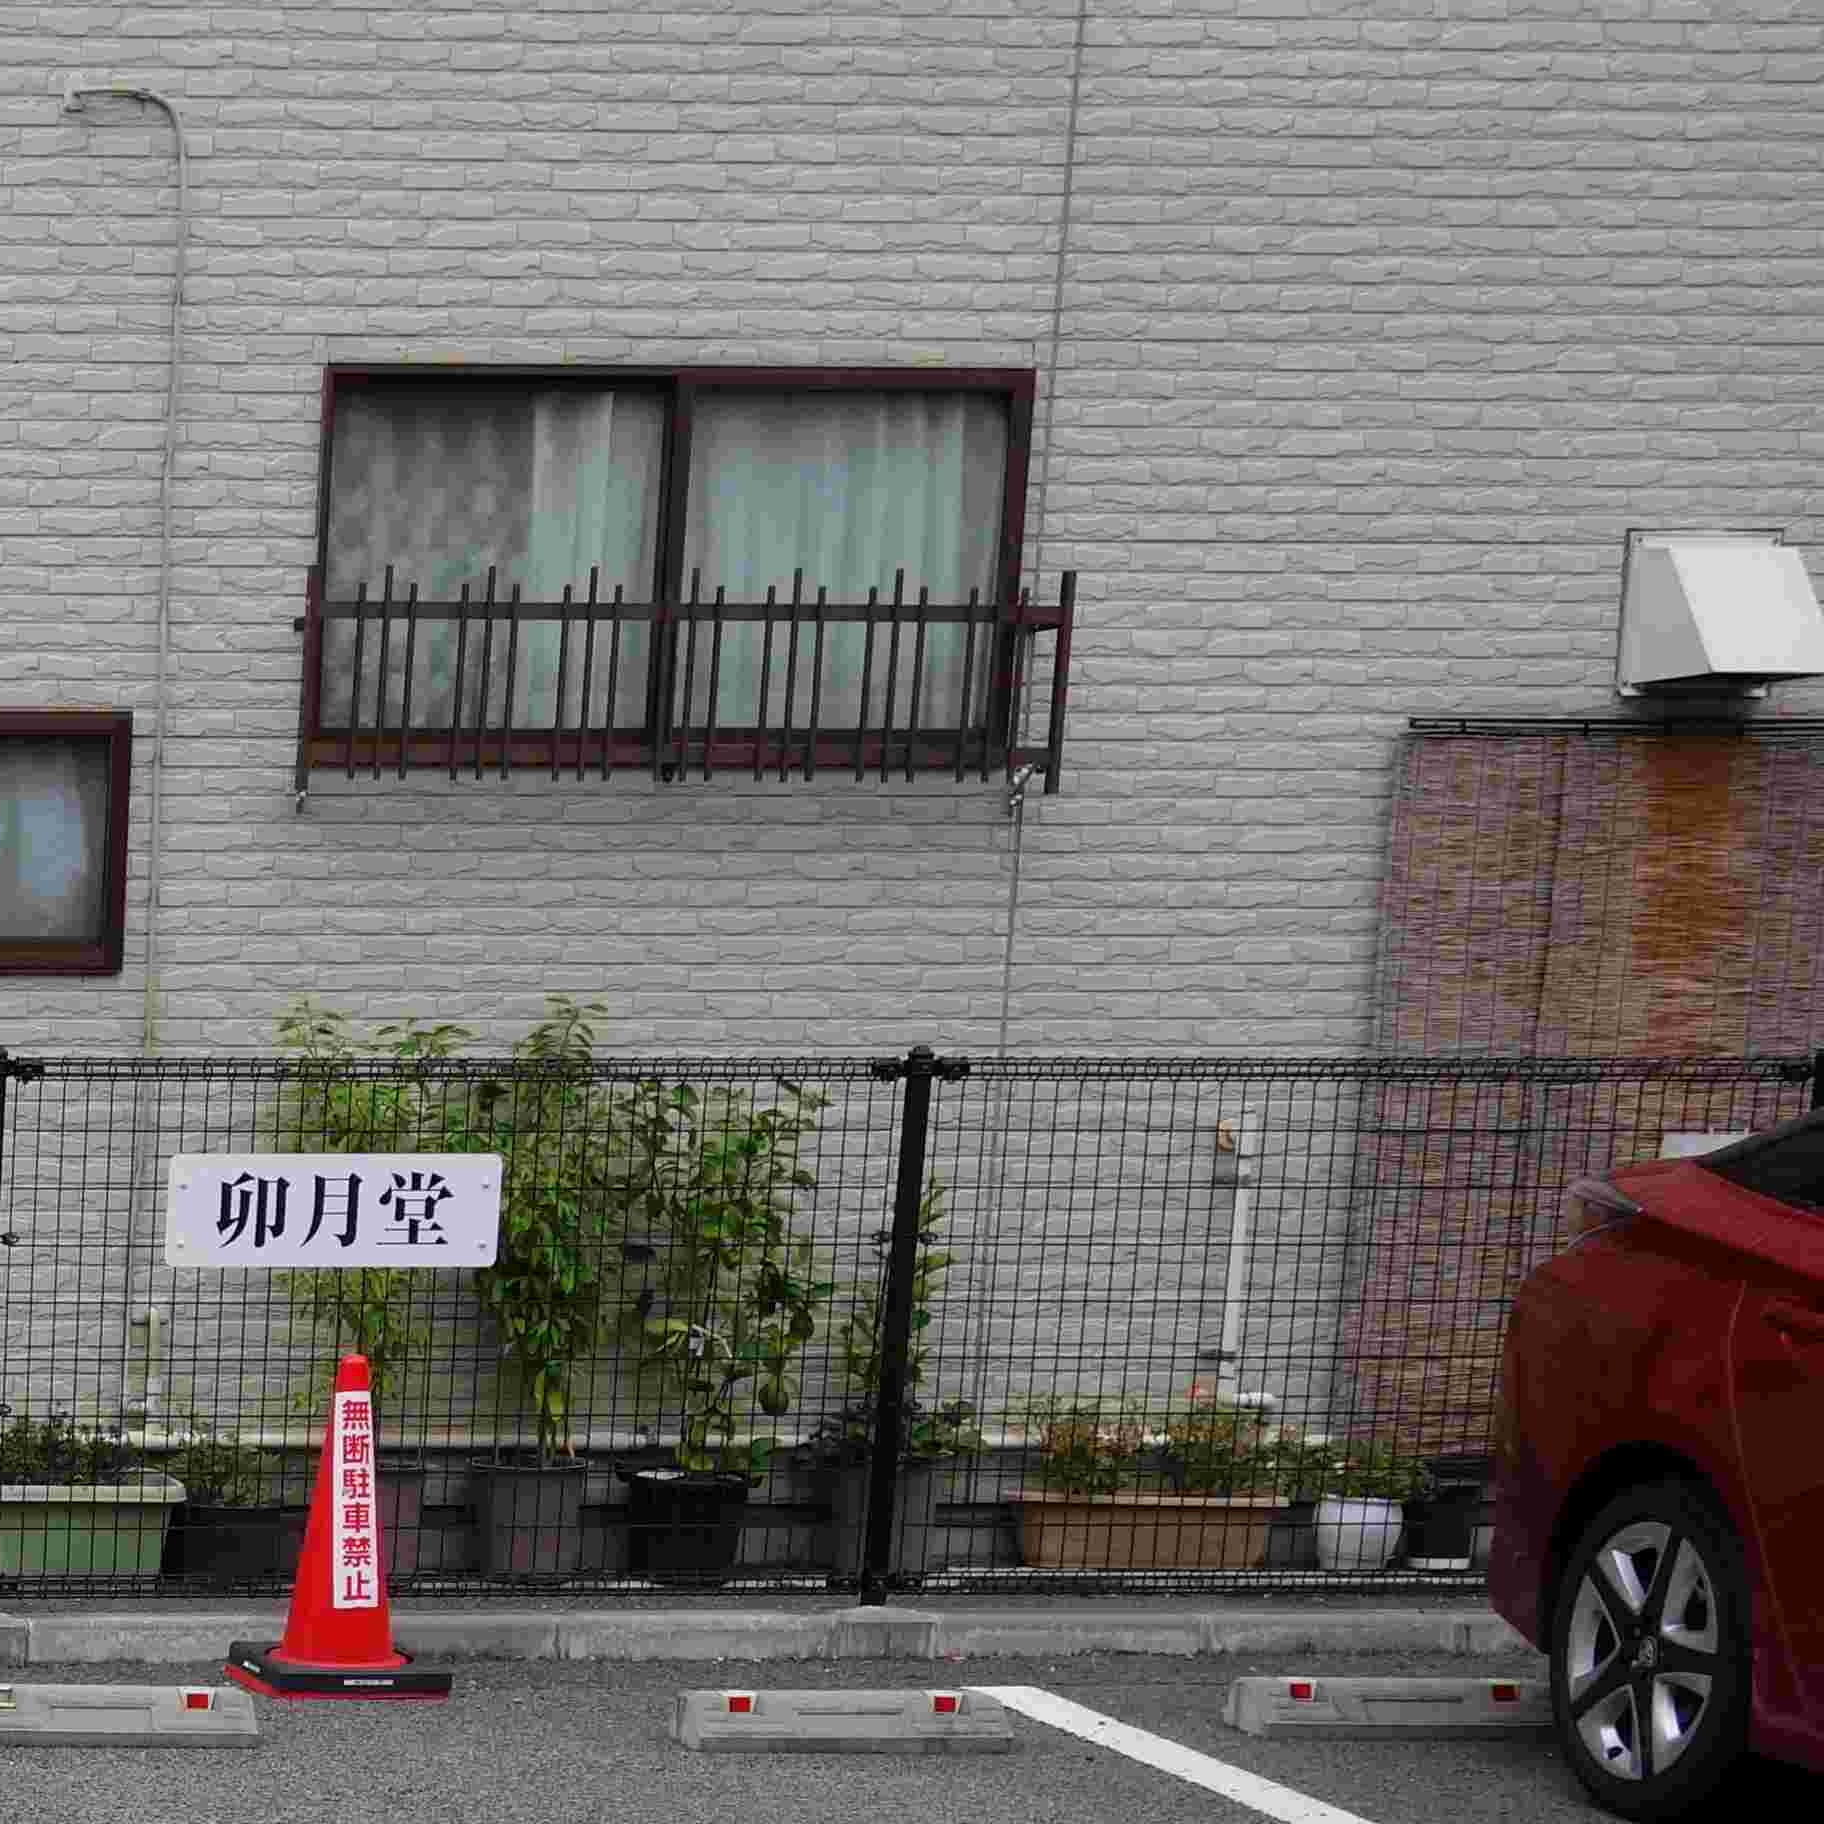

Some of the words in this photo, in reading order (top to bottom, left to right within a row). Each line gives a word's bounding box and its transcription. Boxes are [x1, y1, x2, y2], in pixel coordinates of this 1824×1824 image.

[216, 1171, 454, 1248] 卯月堂
[340, 1399, 372, 1602] 無断駐車禁止
